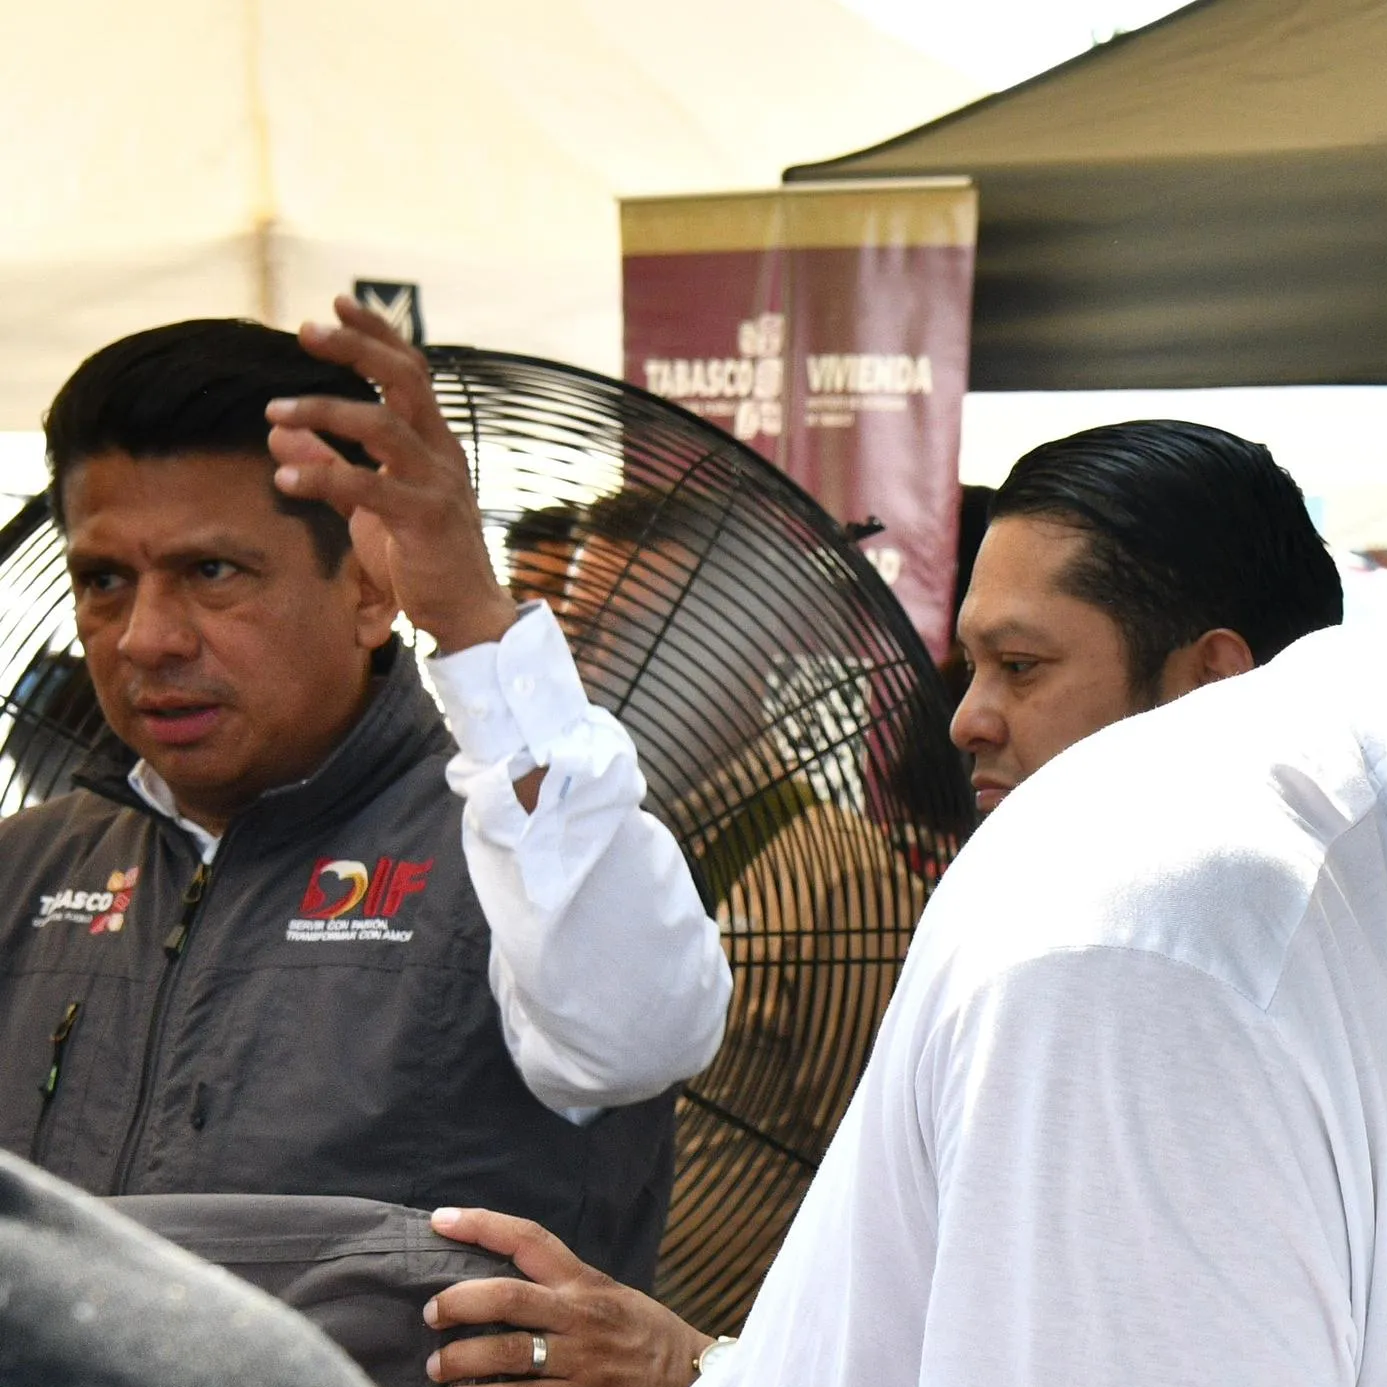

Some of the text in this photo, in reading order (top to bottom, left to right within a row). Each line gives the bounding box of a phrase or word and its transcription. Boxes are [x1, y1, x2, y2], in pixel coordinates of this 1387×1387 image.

[645, 357, 752, 398] TABASCO
[806, 354, 933, 394] VIVIENDA
[299, 855, 434, 918] DIF
[326, 919, 349, 930] CON
